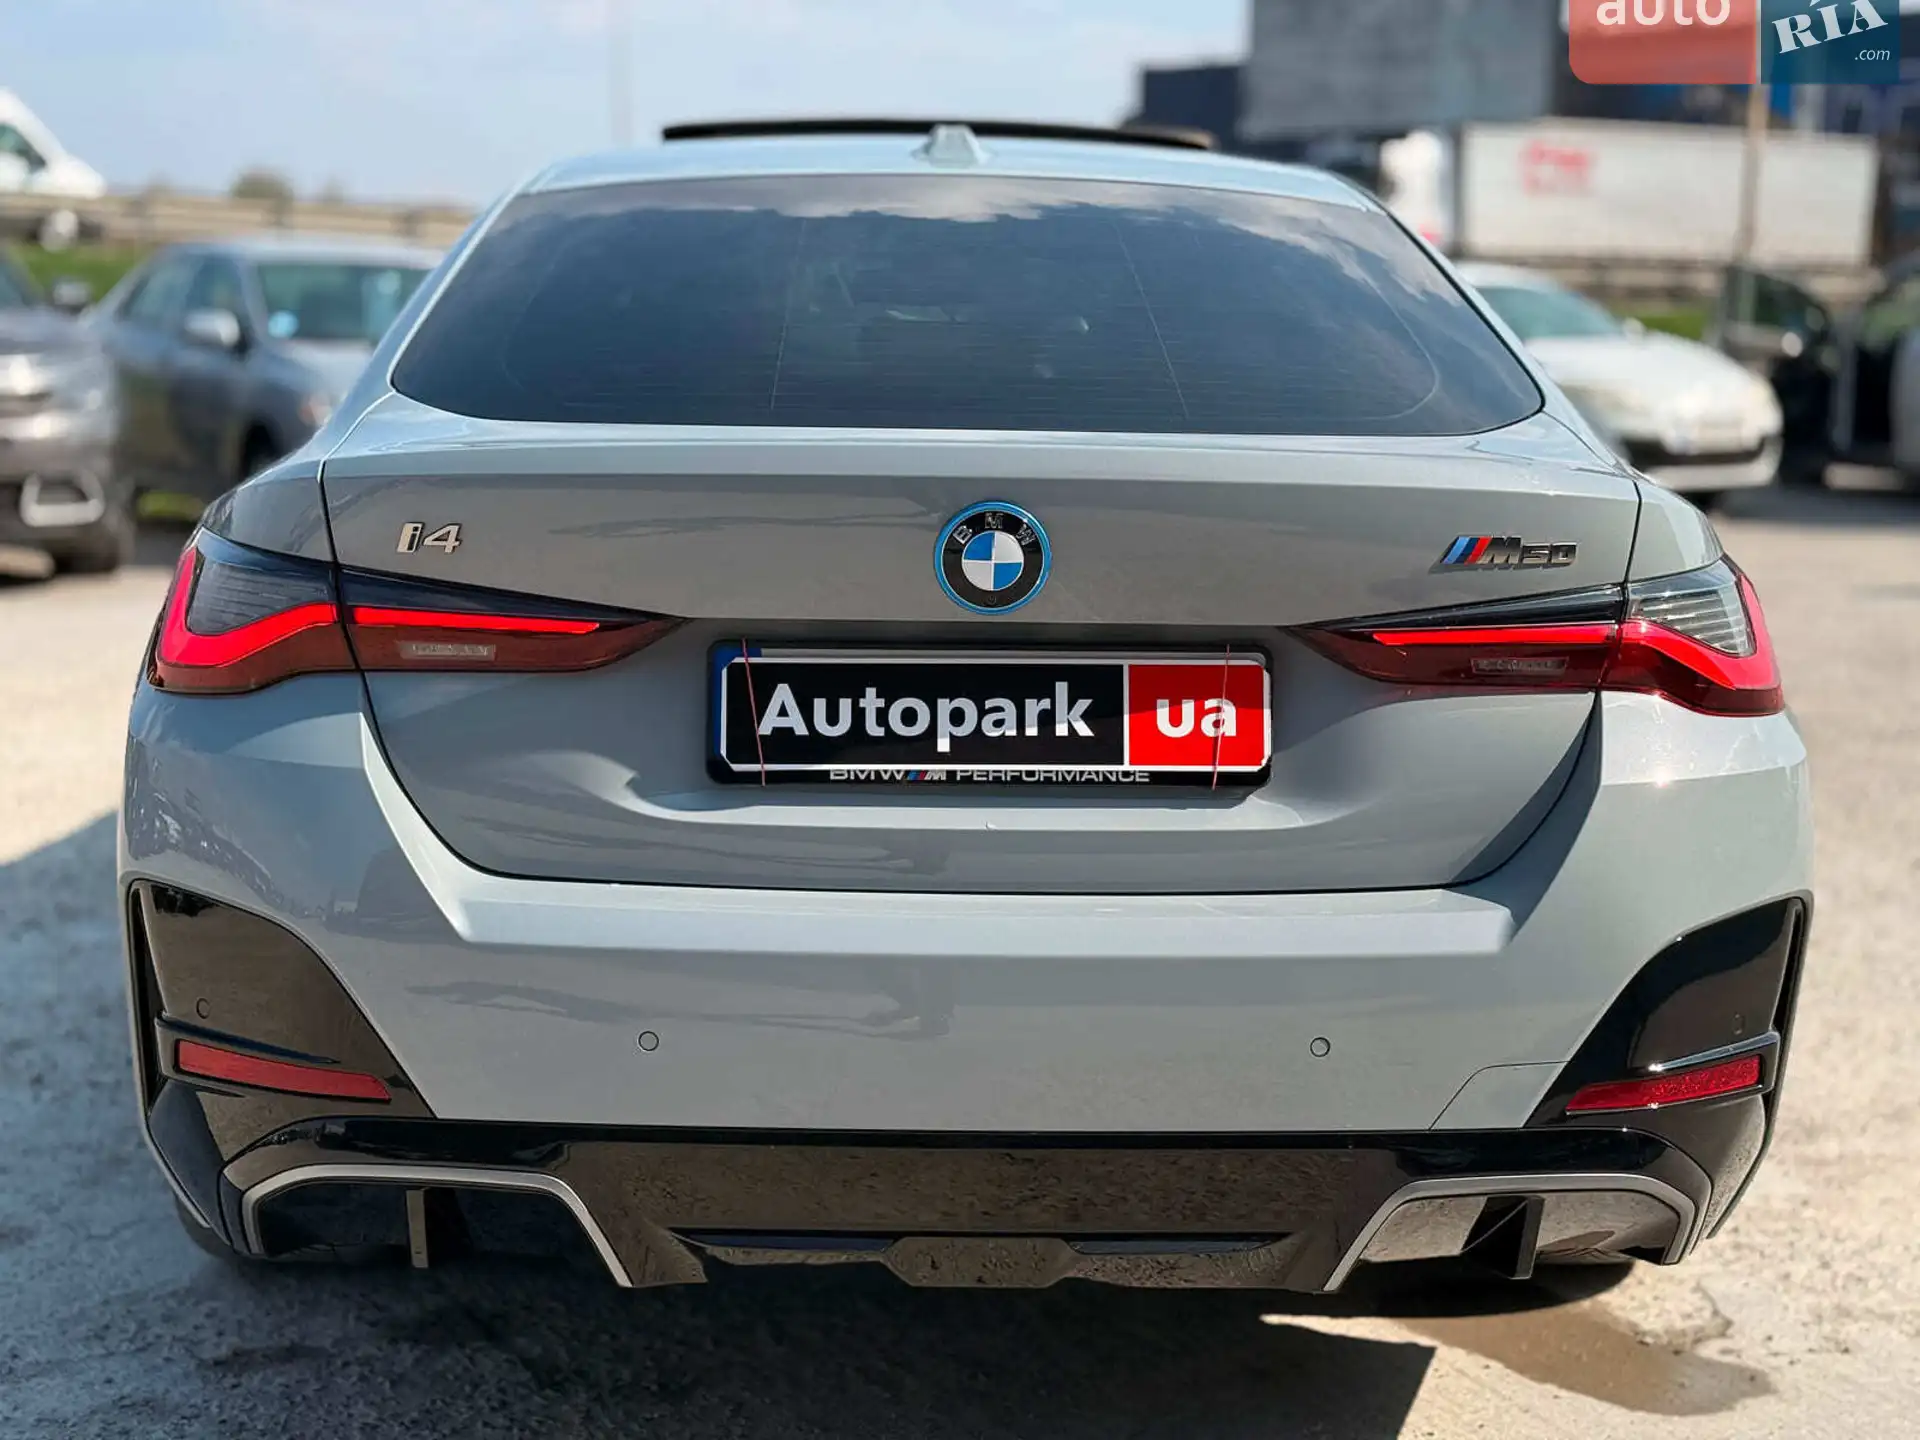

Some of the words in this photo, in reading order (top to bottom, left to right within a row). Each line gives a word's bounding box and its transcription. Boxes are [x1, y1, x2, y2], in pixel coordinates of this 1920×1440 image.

[397, 522, 462, 554] i4
[952, 512, 1036, 546] BMW
[758, 681, 1095, 753] Autopark
[1156, 697, 1237, 738] ua
[829, 769, 906, 781] BMW
[956, 769, 1150, 782] PERFORMANCE
